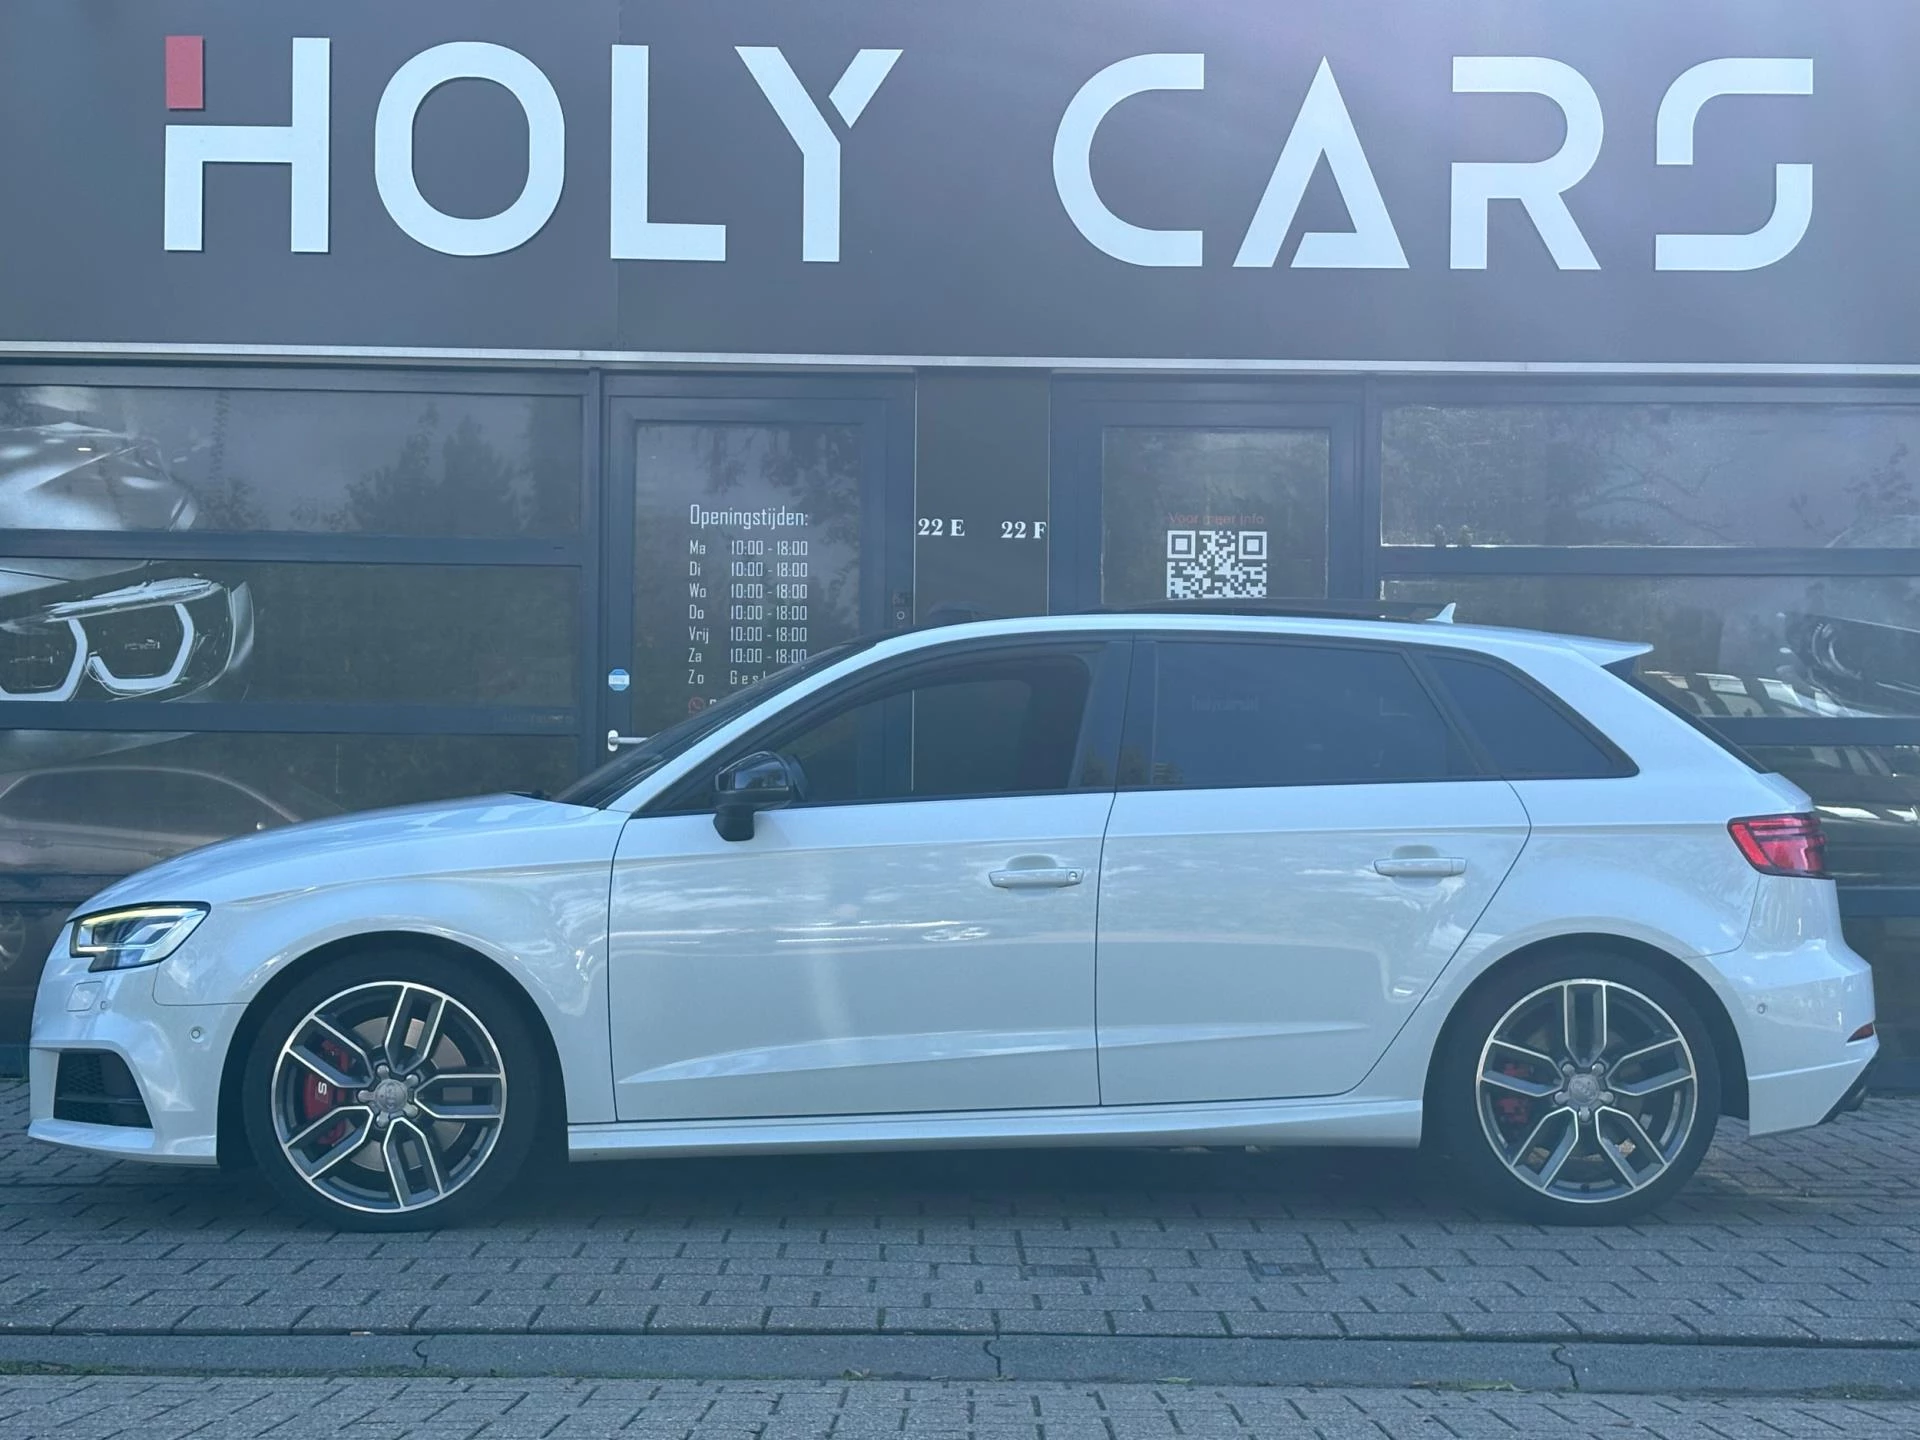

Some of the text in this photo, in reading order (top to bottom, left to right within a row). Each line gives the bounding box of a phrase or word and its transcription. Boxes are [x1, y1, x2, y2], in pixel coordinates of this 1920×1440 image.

[165, 35, 1814, 271] HOLY CARS
[690, 504, 808, 530] Openingstijden:
[1167, 511, 1199, 525] Voor
[917, 518, 966, 537] 22 E
[1001, 521, 1047, 539] 22 F
[689, 540, 706, 555] Ma
[731, 540, 764, 556] 10:00
[776, 540, 808, 556] 18:00
[689, 561, 701, 577] Di
[731, 561, 763, 577] 10:00
[776, 561, 808, 577] 18:00
[689, 583, 707, 598] Wo
[731, 583, 763, 599] 10:00
[776, 583, 808, 599] 18:00
[689, 604, 705, 620] Do
[730, 605, 763, 620] 10:00
[776, 605, 808, 620] 18:00
[688, 626, 709, 644] Vrij
[730, 626, 763, 642] 10:00
[776, 626, 808, 642] 18:00
[688, 647, 702, 663] Za
[730, 648, 763, 664] 10:00
[776, 648, 808, 664] 18:00
[688, 669, 705, 684] Zo
